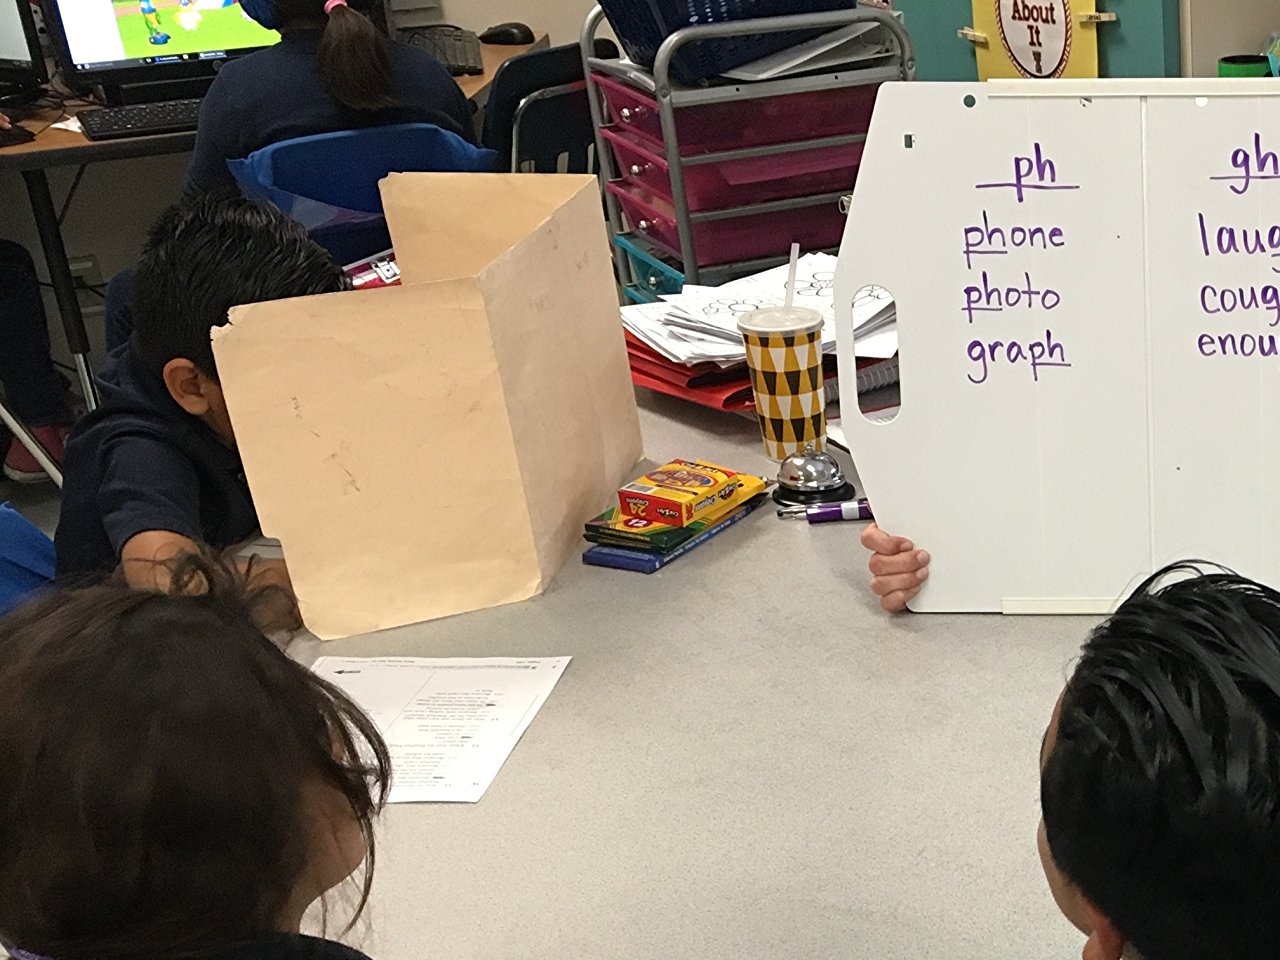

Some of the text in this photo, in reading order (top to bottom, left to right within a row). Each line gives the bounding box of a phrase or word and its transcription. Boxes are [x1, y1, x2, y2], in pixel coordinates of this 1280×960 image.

[1011, 0, 1056, 24] About
[1027, 25, 1042, 47] It
[1013, 142, 1057, 203] ph
[1230, 132, 1279, 195] gh
[963, 210, 1066, 270] phone
[962, 272, 1061, 326] photo
[967, 329, 1071, 384] graph
[628, 518, 648, 528] 12
